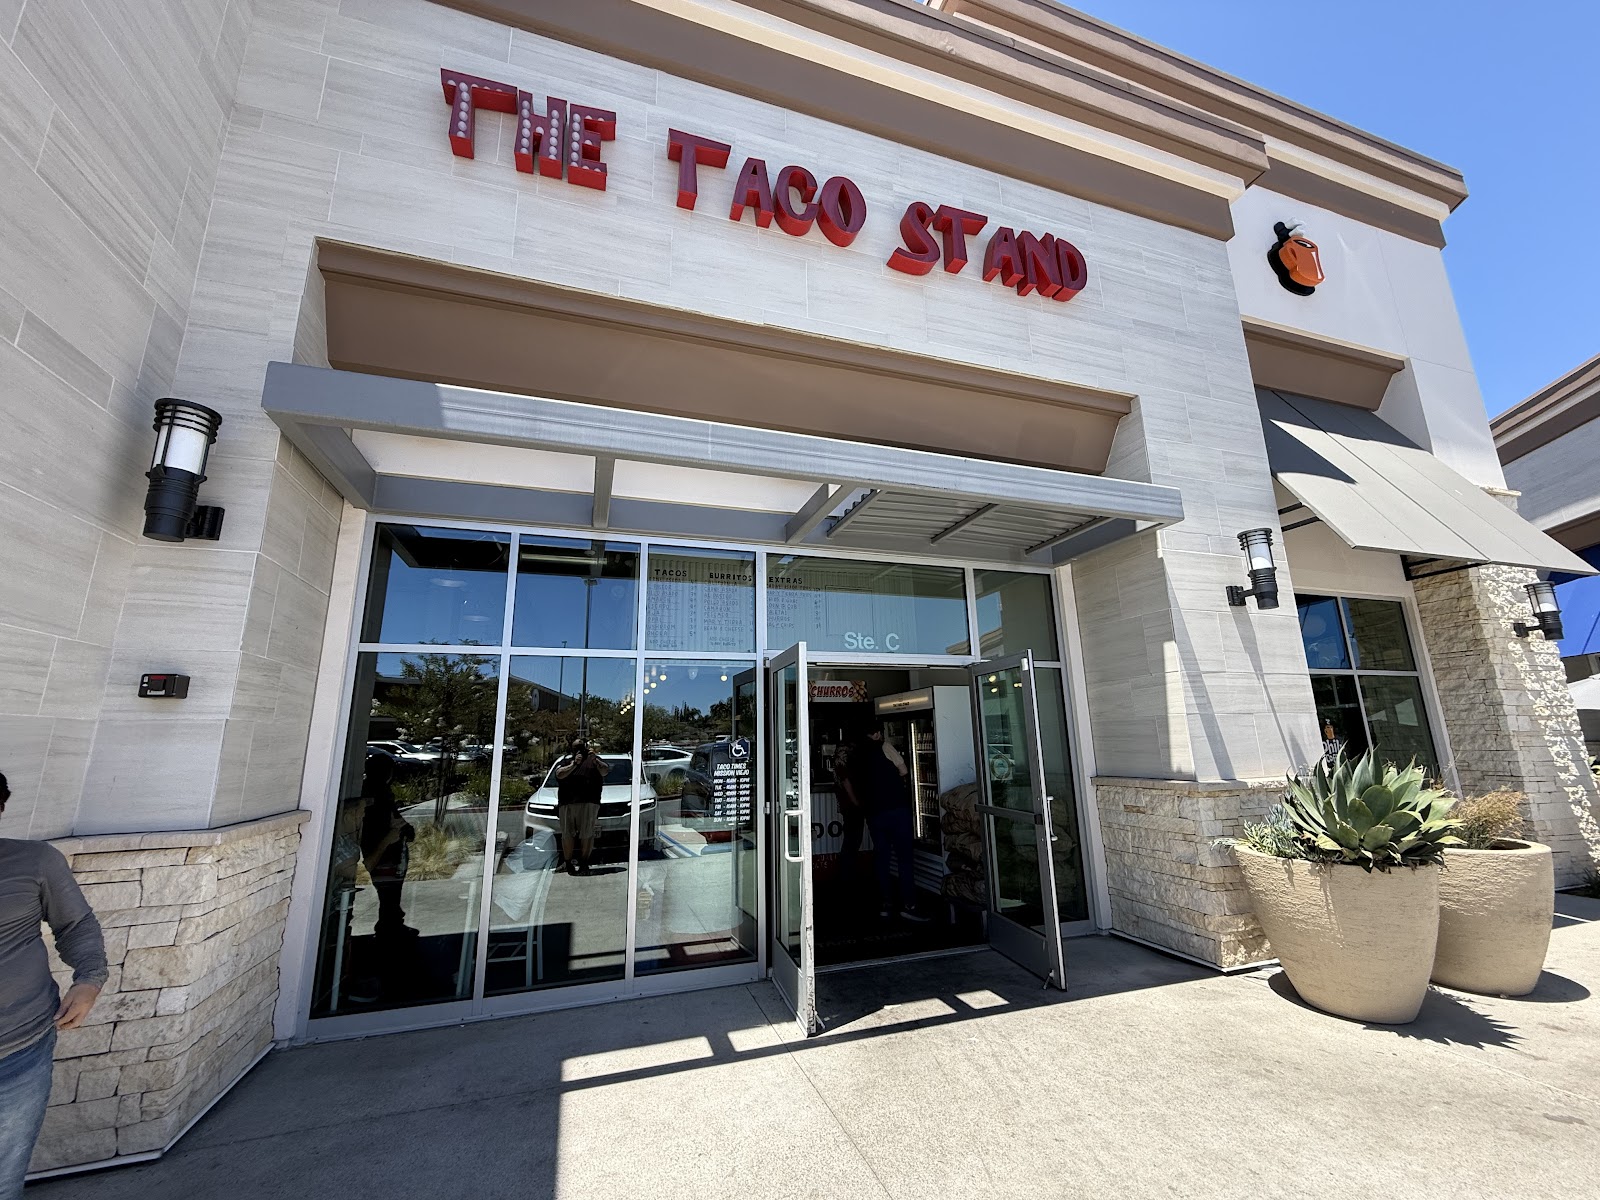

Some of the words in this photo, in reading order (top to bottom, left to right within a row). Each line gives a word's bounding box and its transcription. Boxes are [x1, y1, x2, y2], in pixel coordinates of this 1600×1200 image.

[441, 68, 617, 190] THE
[667, 128, 867, 247] TACO
[886, 201, 1088, 302] STAND
[654, 569, 687, 577] TACOS
[709, 572, 752, 582] BURRITOS
[768, 576, 802, 584] EXTRAS
[844, 632, 878, 650] Ste.
[886, 633, 900, 651] C
[810, 685, 854, 698] CHURROS
[1322, 739, 1342, 754] Phil
